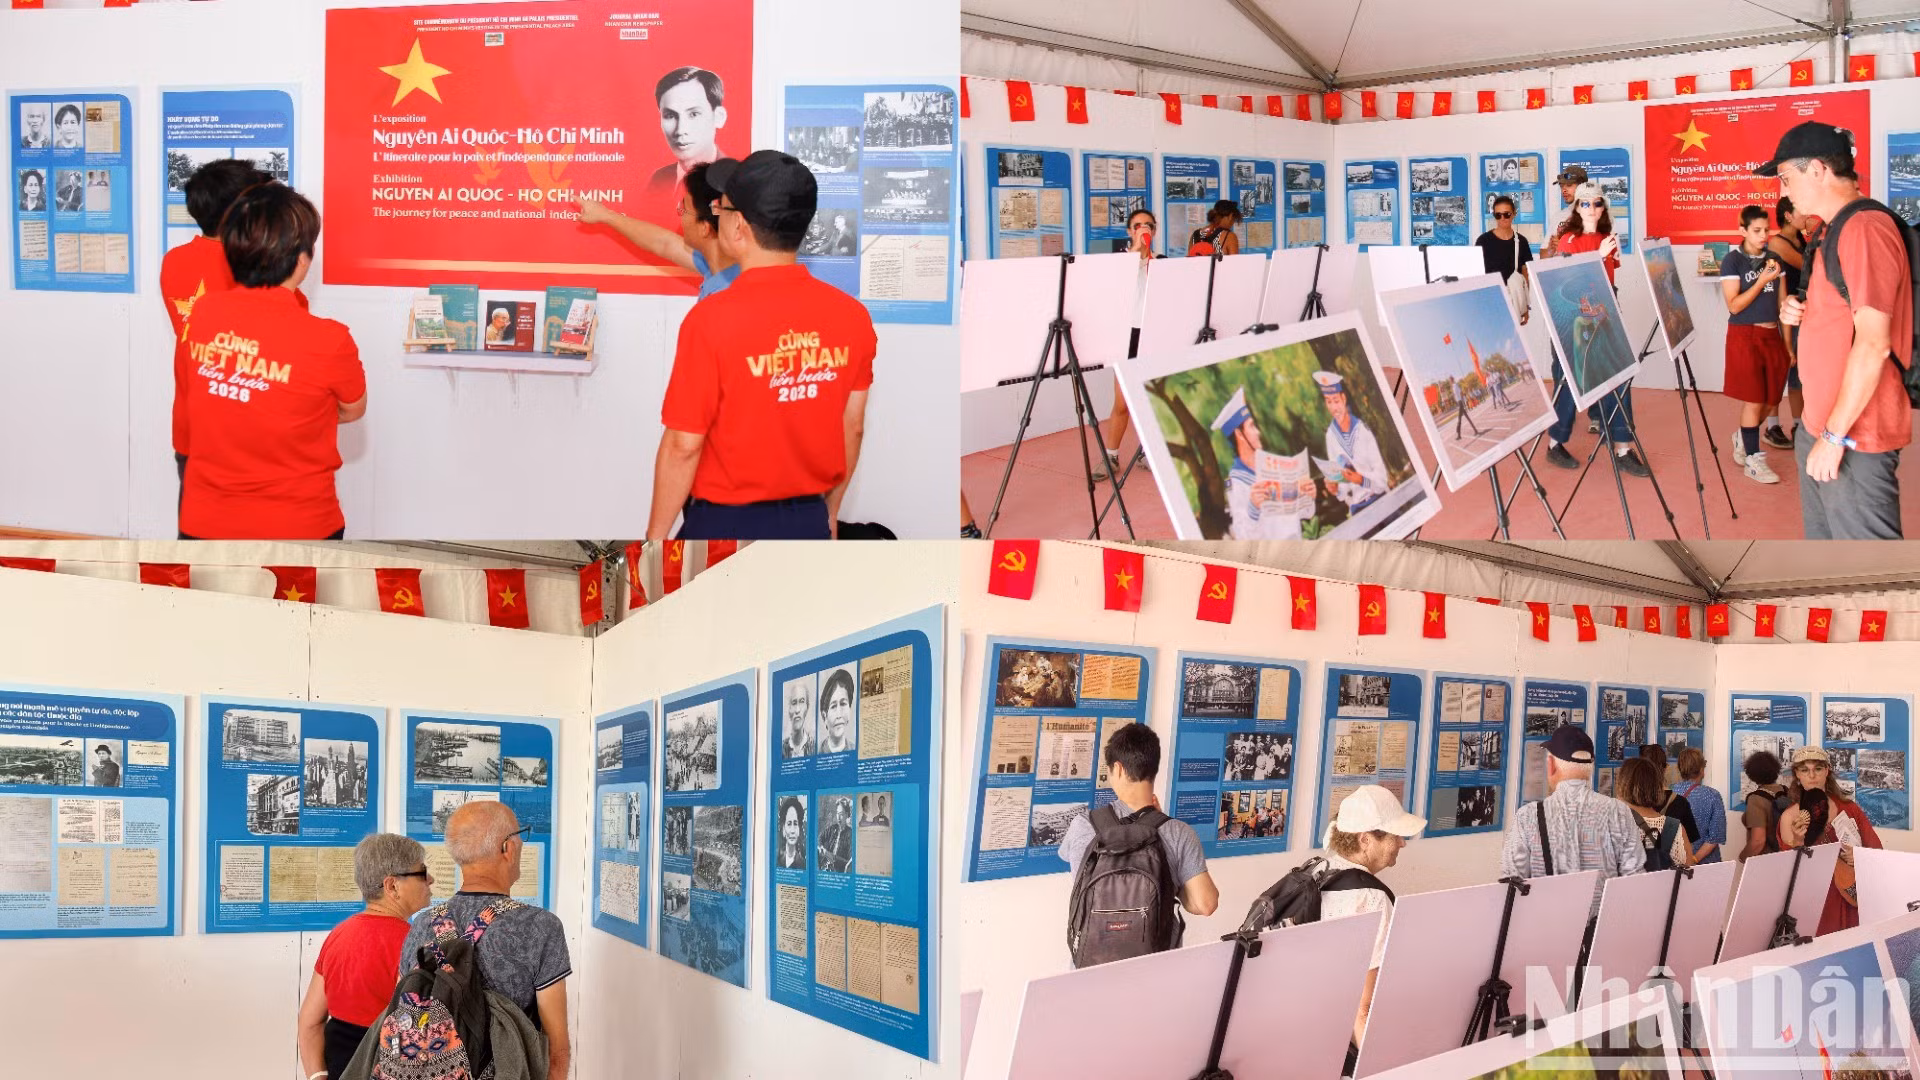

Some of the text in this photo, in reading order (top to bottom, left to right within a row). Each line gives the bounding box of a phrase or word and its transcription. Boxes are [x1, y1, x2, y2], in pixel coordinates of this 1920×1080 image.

[373, 114, 427, 125] L'exposition
[441, 128, 459, 145] Ai
[546, 127, 577, 144] Chi
[579, 127, 625, 144] Minh
[428, 153, 451, 164] pour
[452, 151, 464, 162] la
[464, 152, 484, 164] paix
[485, 152, 497, 162] et
[575, 151, 625, 162] nationale
[373, 174, 423, 184] Exhibition
[372, 187, 434, 201] NGUYEN
[437, 187, 453, 201] AI
[456, 188, 504, 203] QUOC
[518, 188, 543, 202] HO
[547, 188, 575, 203] CHI
[579, 189, 624, 203] MINH
[1715, 193, 1741, 201] QUOC
[1748, 192, 1761, 200] HO
[1763, 192, 1777, 200] CHI
[373, 206, 391, 217] The
[392, 208, 431, 220] journey
[432, 208, 447, 218] for
[448, 210, 479, 220] peace
[480, 209, 501, 219] and
[502, 209, 546, 219] national
[801, 346, 849, 370] NAM
[236, 353, 293, 385] NAM
[208, 380, 251, 403] 2026
[777, 383, 818, 403] 2026
